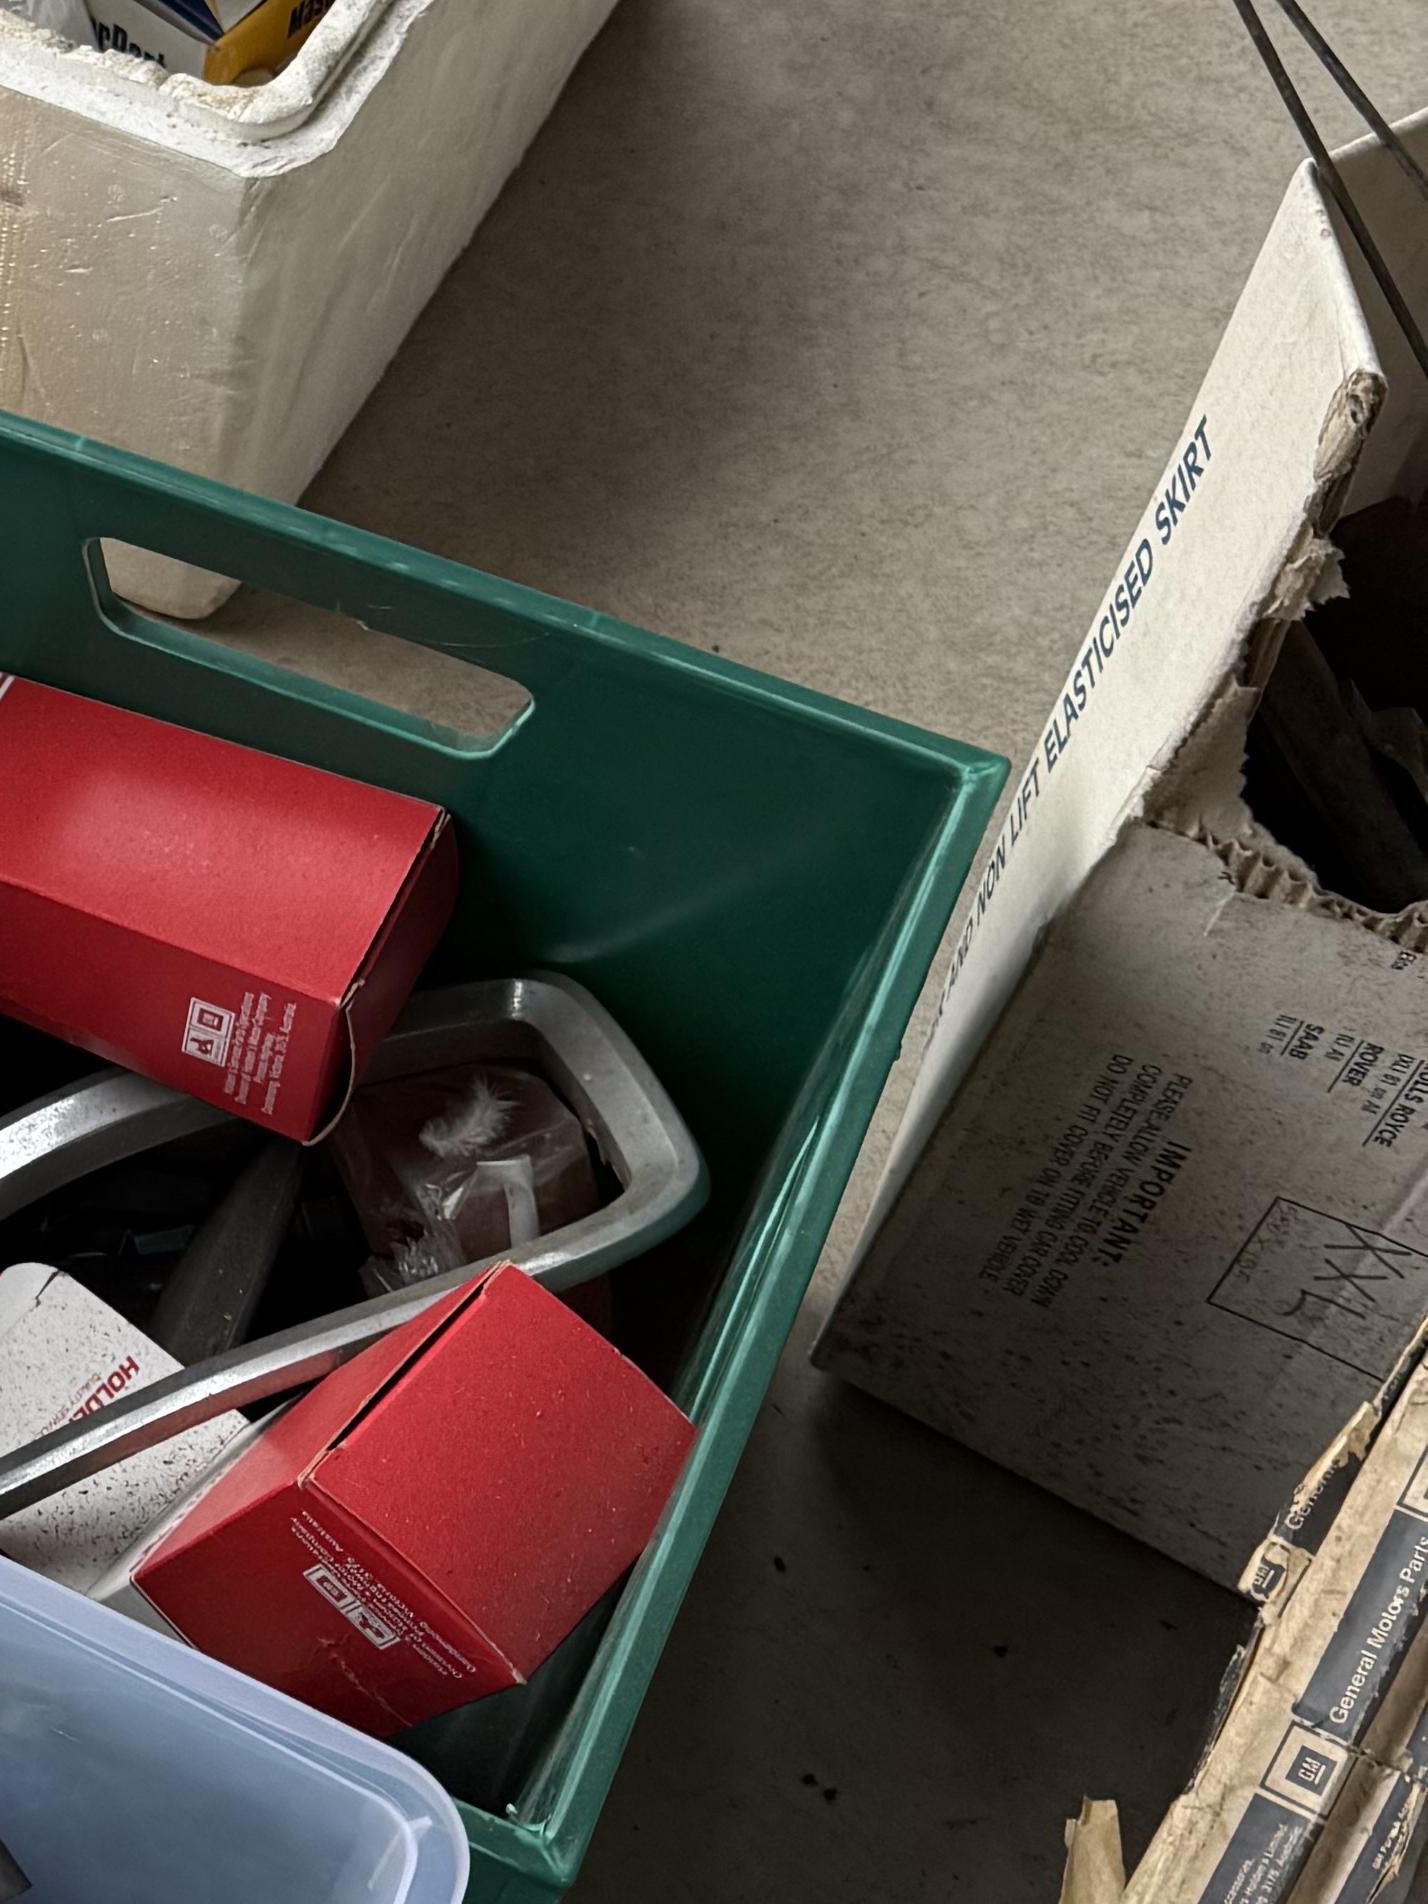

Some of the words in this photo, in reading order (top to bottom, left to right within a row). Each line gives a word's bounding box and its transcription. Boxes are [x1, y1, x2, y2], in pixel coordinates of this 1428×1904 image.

[971, 834, 1010, 925] NON
[1006, 757, 1041, 846] LIFT
[1038, 537, 1158, 771] ELASTICISED
[1149, 413, 1217, 546] SKIRT
[1287, 1021, 1325, 1062] SAAB
[1104, 1052, 1133, 1077] DO
[1341, 1042, 1384, 1088] ROVER
[1403, 1063, 1428, 1105] OLLS
[1087, 1073, 1118, 1104] NOT
[1100, 1063, 1161, 1143] COMPLETELY
[1147, 1072, 1193, 1121] PLEASE
[1074, 1102, 1100, 1125] FIT
[1372, 1102, 1416, 1149] ROYCE
[1048, 1121, 1088, 1167] COVER
[1120, 1116, 1160, 1167] ALLOW
[1034, 1165, 1060, 1189] ON
[1069, 1139, 1112, 1190] BEFORE
[1023, 1184, 1048, 1208] TO
[1042, 1184, 1084, 1233] FITTING
[1086, 1163, 1134, 1220] VEHICLE
[1090, 1138, 1192, 1271] IMPORTANT:
[1007, 1205, 1036, 1234] WET
[1073, 1214, 1099, 1239] TO
[1025, 1228, 1057, 1260] CAR
[1053, 1231, 1087, 1269] COOL
[1001, 1252, 1041, 1296] COVER
[1029, 1265, 1068, 1310] DOWN
[1273, 1224, 1411, 1318] XXL
[67, 1355, 141, 1423] HOLDE
[1325, 1647, 1379, 1724] General
[1363, 1580, 1412, 1650] Motors
[1396, 1533, 1428, 1584] Parts
[1295, 1754, 1327, 1786] GM
